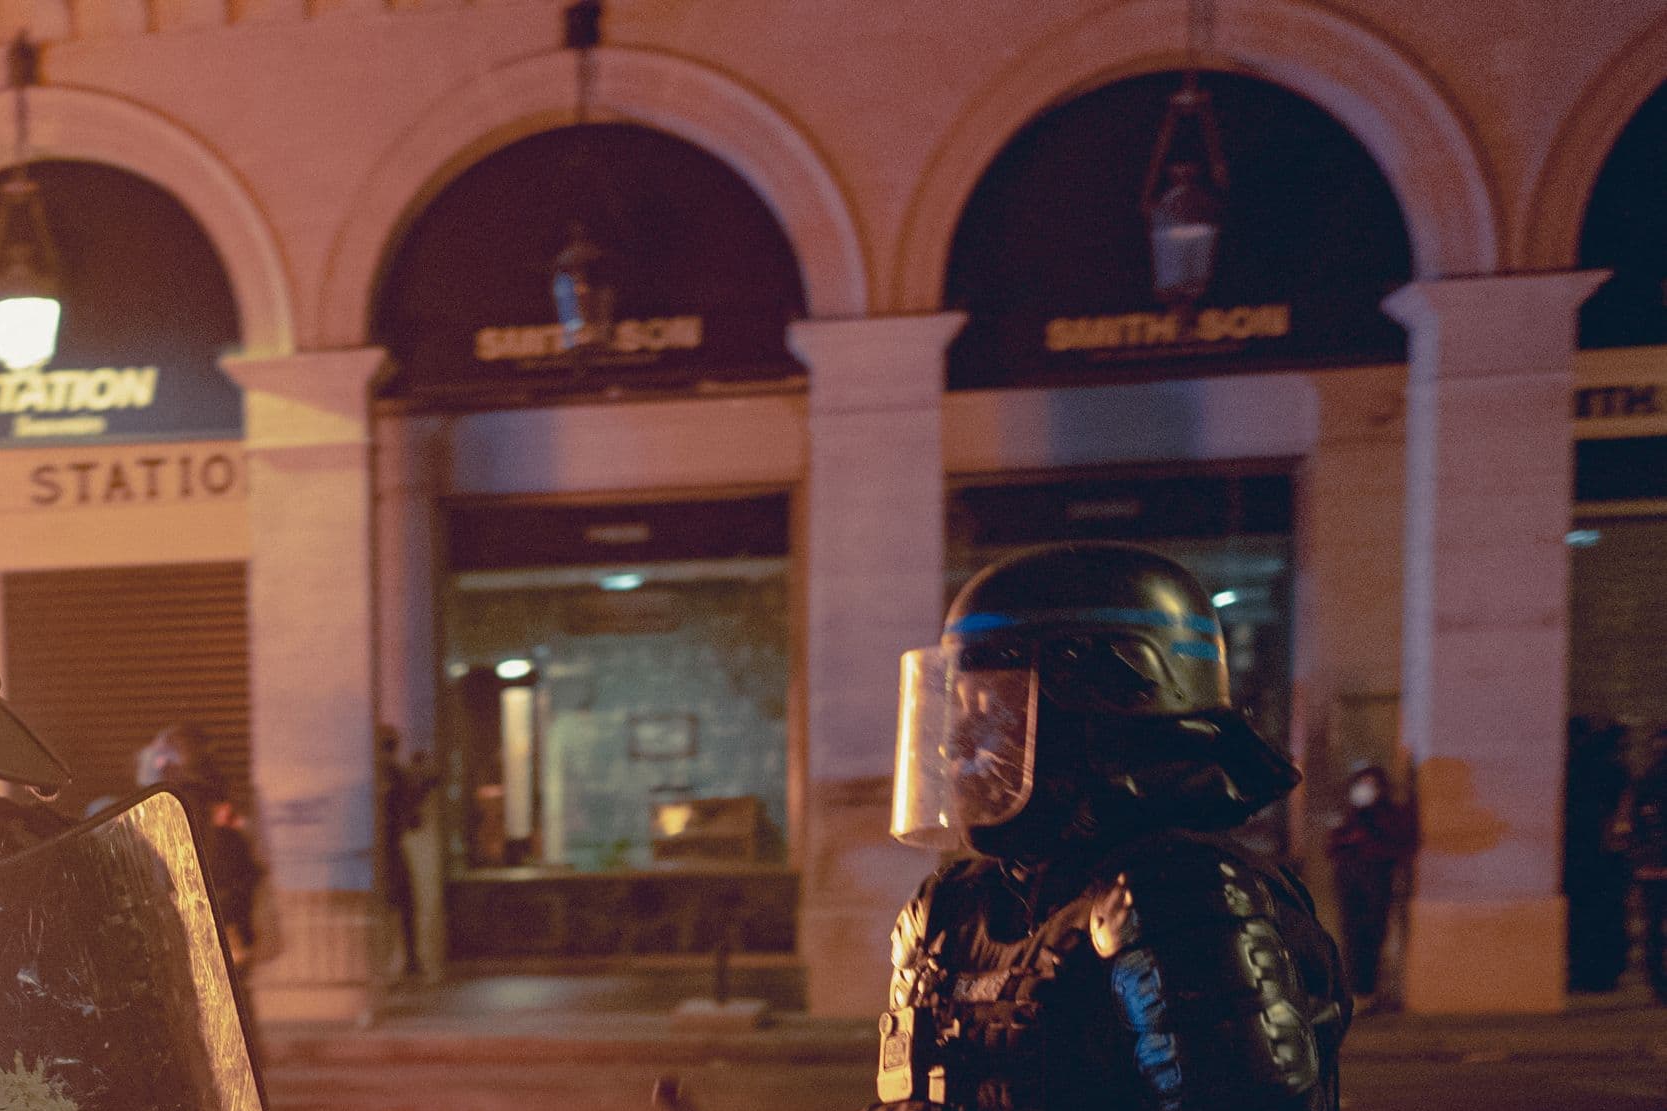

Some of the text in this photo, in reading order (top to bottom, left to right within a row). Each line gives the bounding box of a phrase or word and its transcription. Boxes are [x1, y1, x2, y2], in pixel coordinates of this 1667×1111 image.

[614, 316, 703, 352] SON
[1045, 303, 1290, 351] SMITH SON
[32, 453, 245, 505] STATIO
